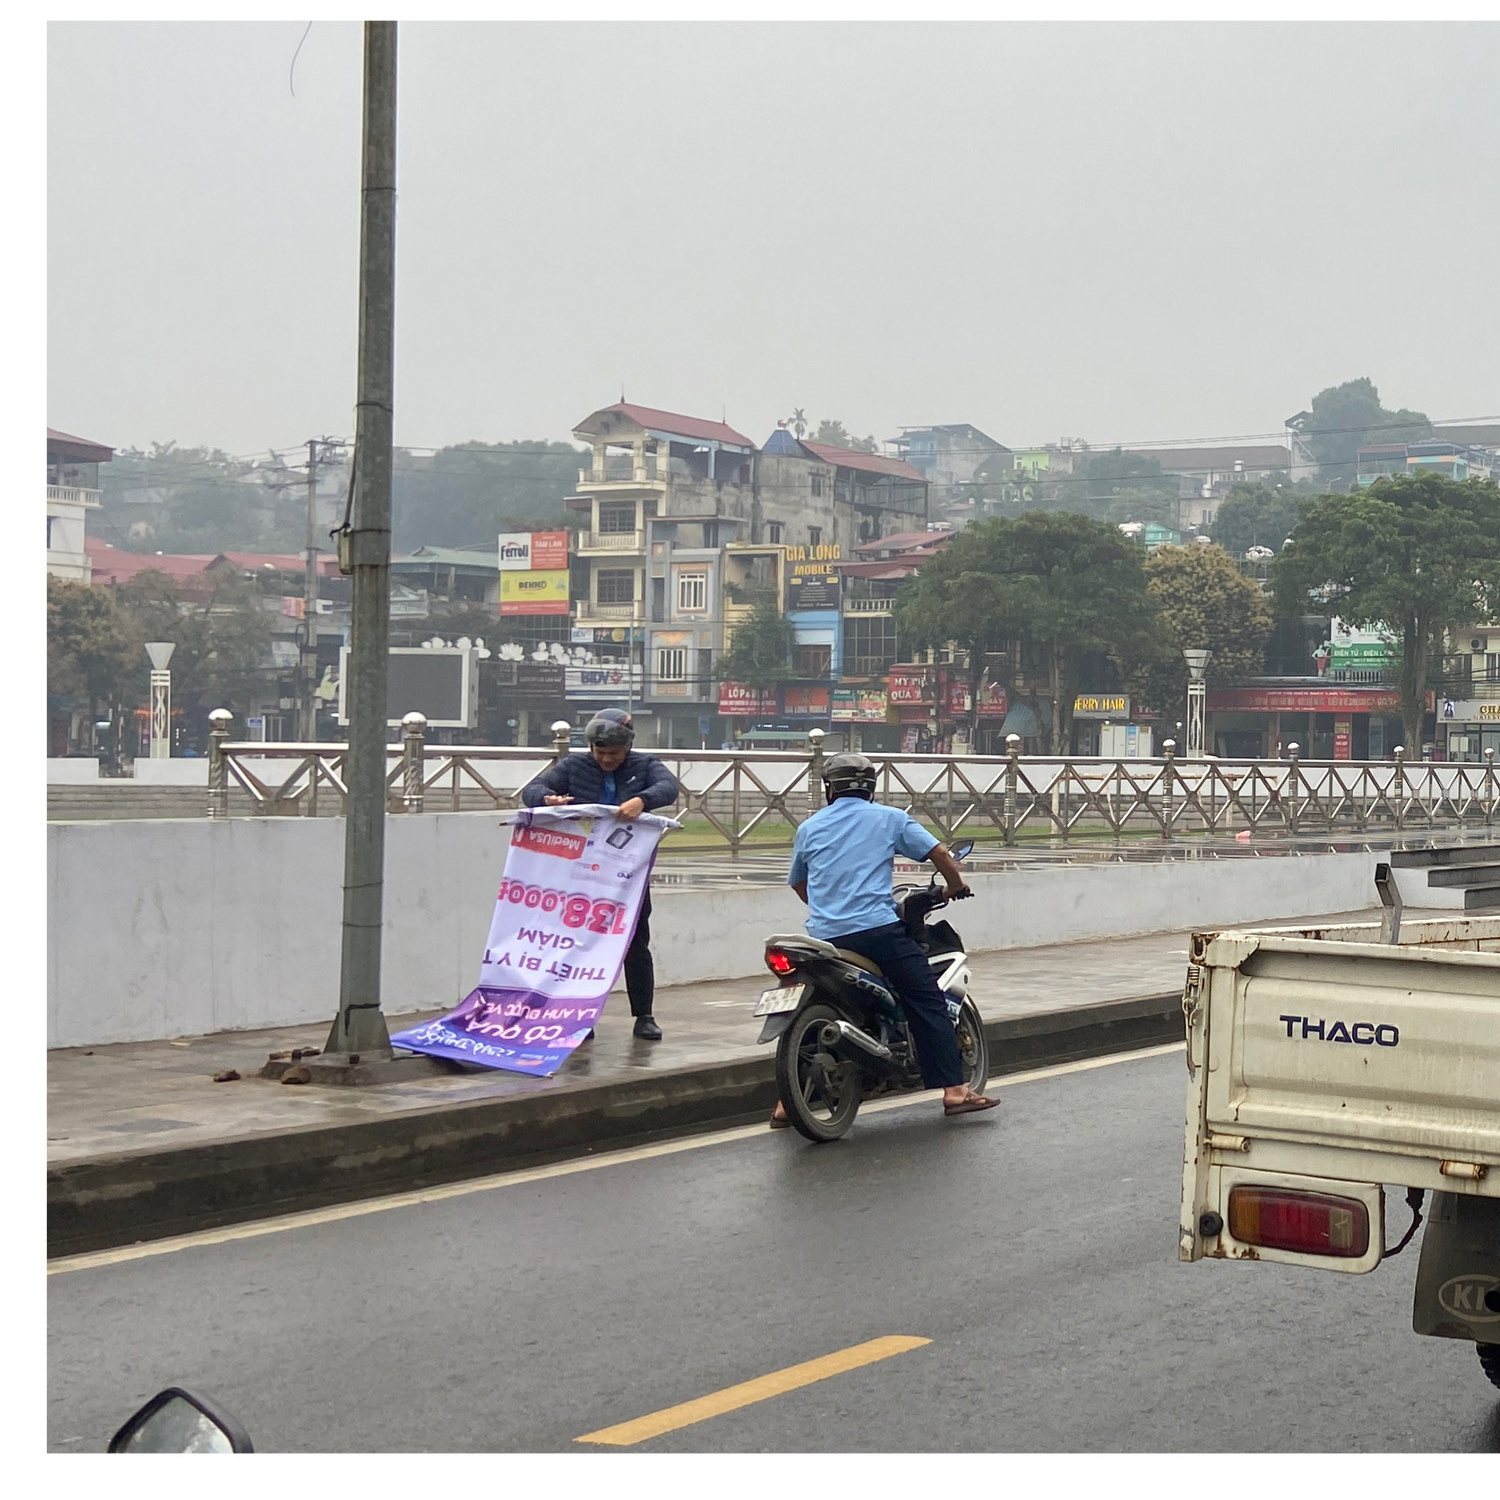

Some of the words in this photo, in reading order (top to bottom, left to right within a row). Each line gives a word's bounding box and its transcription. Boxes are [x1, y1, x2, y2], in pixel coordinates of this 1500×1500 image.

[809, 544, 840, 560] LONG
[794, 564, 833, 575] MOBILE
[581, 670, 610, 684] BIDV
[1102, 697, 1125, 710] HAIR
[497, 952, 512, 967] Y
[1279, 1014, 1401, 1048] THACO
[1453, 1283, 1486, 1311] KI
